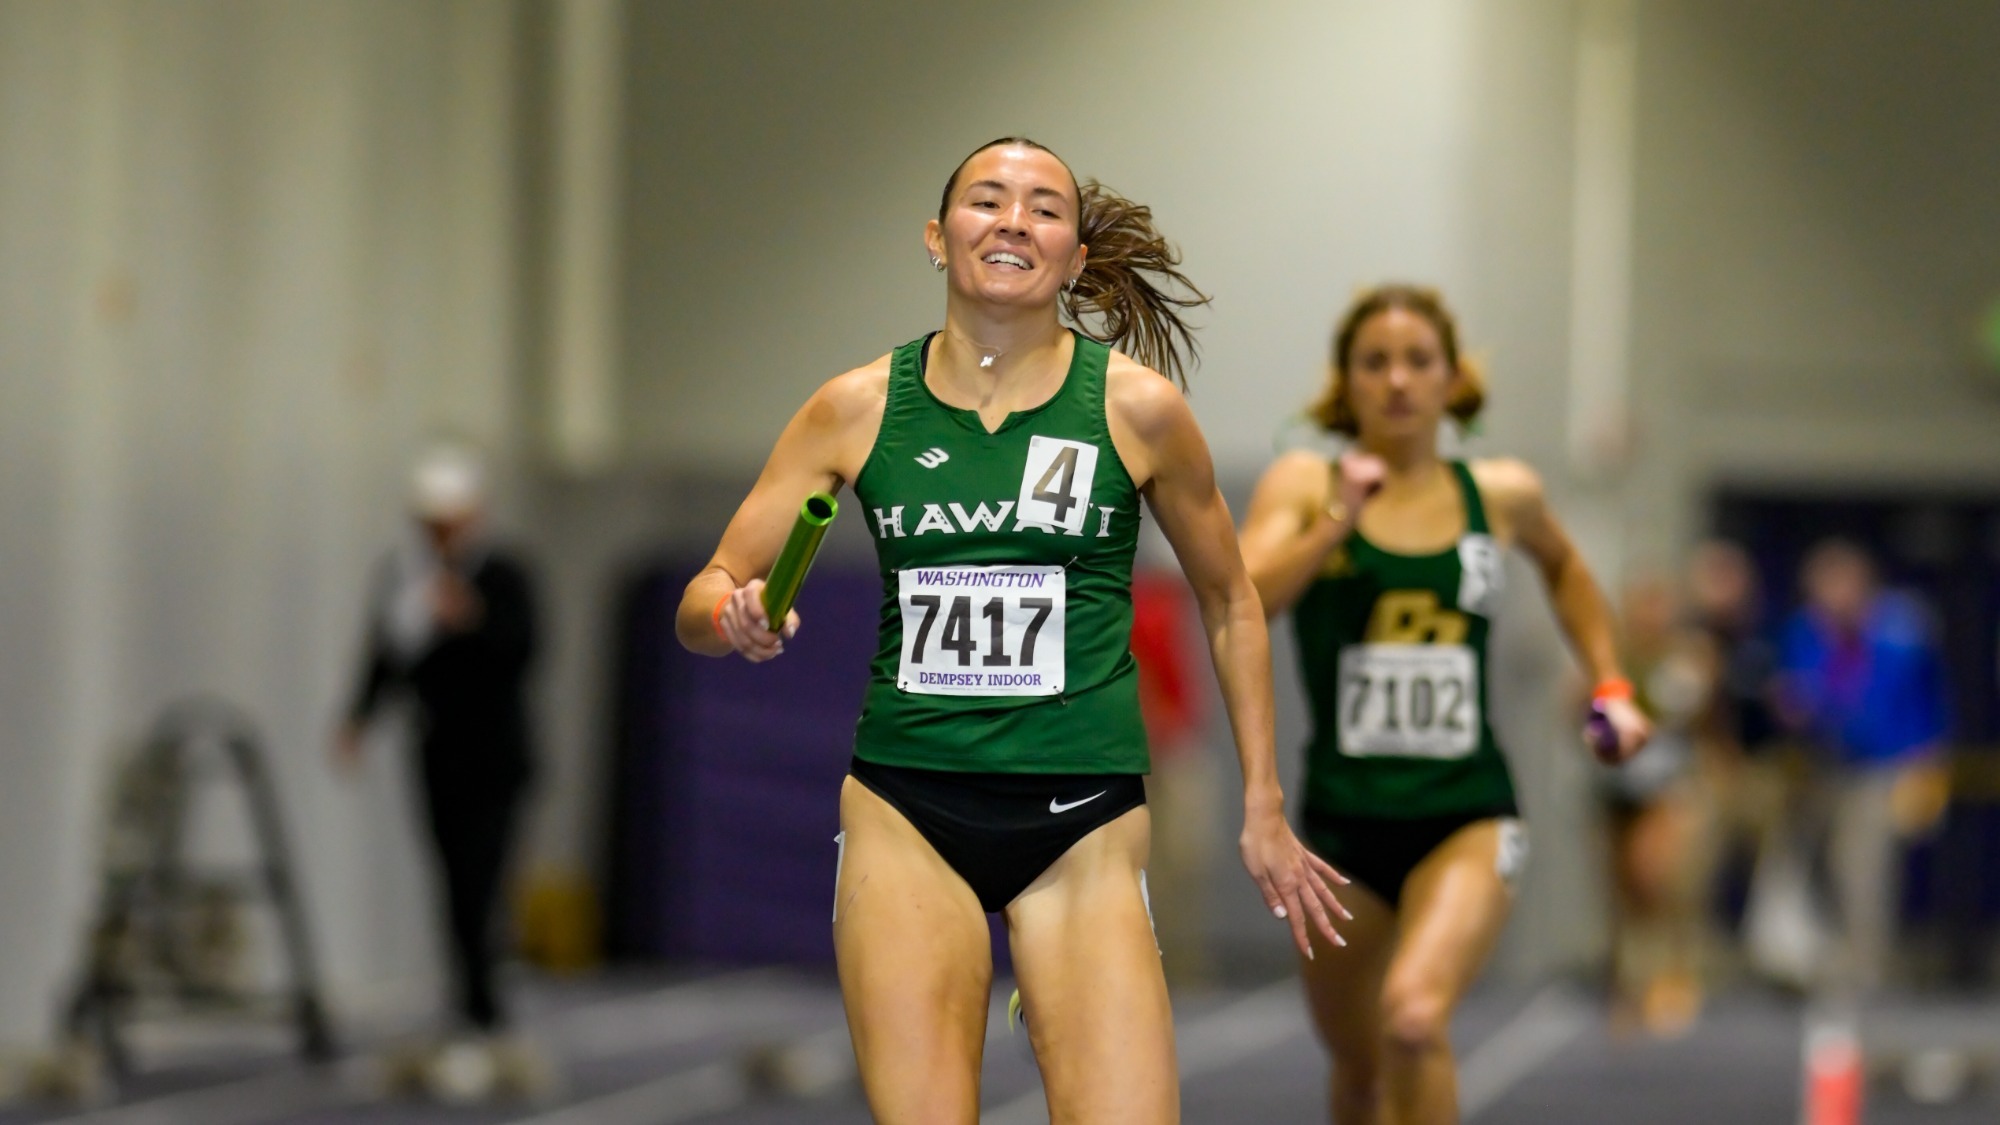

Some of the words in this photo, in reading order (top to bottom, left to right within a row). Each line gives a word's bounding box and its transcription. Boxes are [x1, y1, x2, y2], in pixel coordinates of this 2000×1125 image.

[1031, 446, 1079, 523] 4
[917, 571, 1046, 588] WASHINGTON
[910, 595, 1052, 667] 7417
[920, 672, 983, 686] DEMPSEY
[988, 674, 1041, 686] INDOOR
[1344, 672, 1465, 733] 7102
